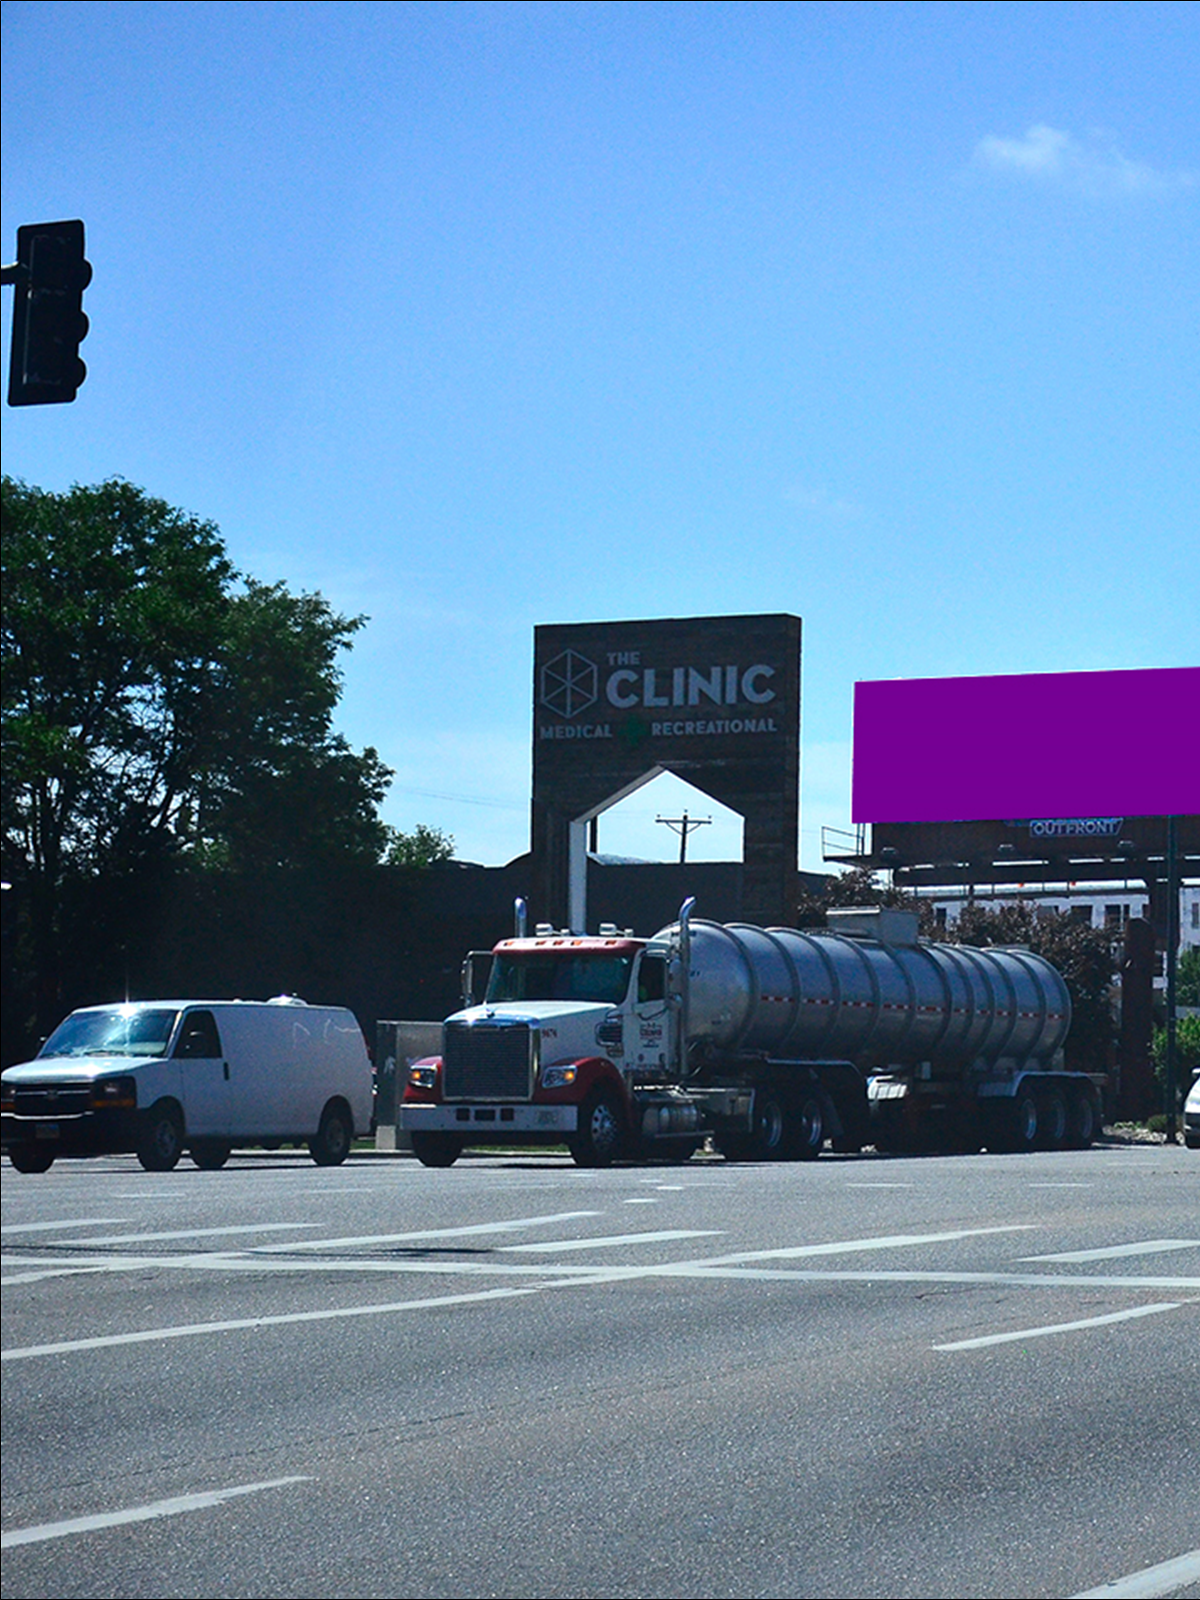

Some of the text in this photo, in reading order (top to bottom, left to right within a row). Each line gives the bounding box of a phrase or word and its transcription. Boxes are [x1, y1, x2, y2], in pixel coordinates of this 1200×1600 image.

[606, 651, 640, 666] THE
[605, 664, 776, 709] CLINIC
[540, 718, 778, 740] MEDICAL RECREATIONAL
[1032, 821, 1116, 836] OUTFRONT
